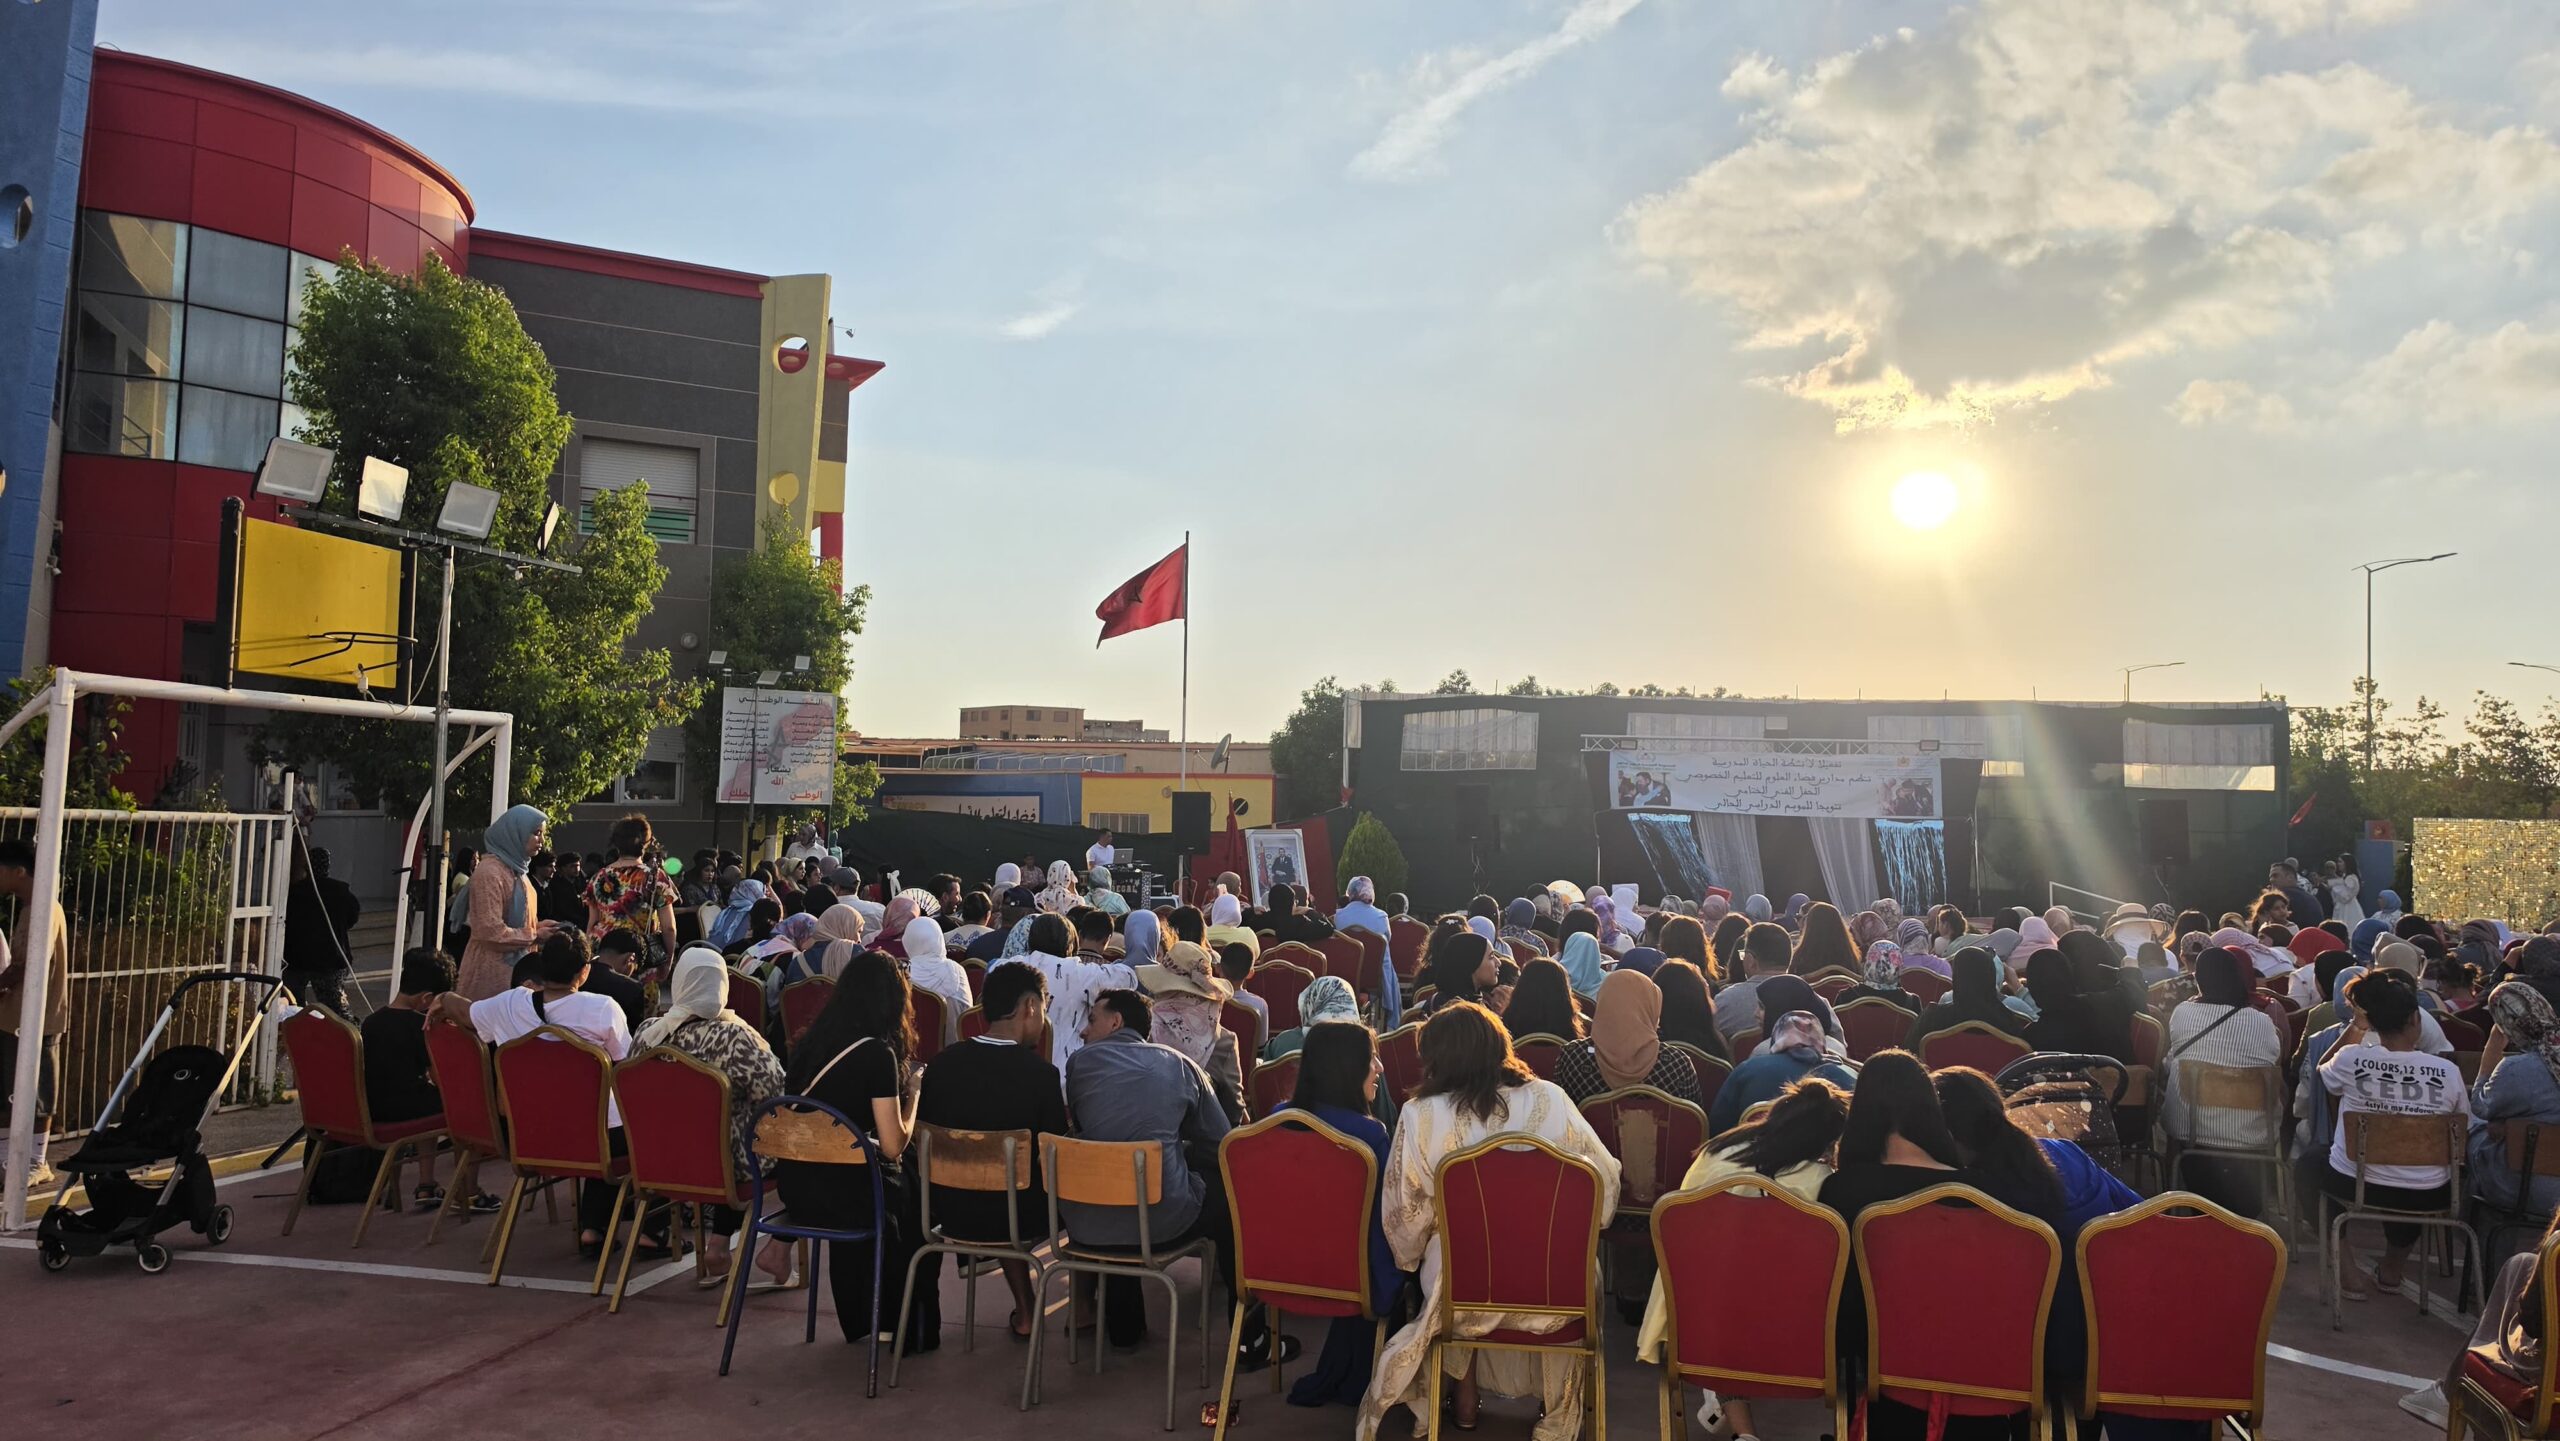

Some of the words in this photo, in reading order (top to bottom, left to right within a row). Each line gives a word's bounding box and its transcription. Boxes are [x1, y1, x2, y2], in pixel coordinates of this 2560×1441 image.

[1711, 757, 1749, 769] المدرسية
[1752, 757, 1779, 768] الحياة
[771, 776, 784, 786] الله
[1675, 770, 1730, 784] الخصوصي
[1733, 770, 1762, 783] للتعليم
[1765, 771, 1791, 786] العلوم
[790, 789, 823, 801] الوطن
[1722, 785, 1768, 798] الختامي
[1791, 786, 1820, 800] الحفل
[1703, 798, 1742, 810] الحالي
[1736, 799, 1781, 812] الدراسي
[1785, 800, 1813, 814] للموسم
[1816, 801, 1842, 814] تتويجا
[2353, 1057, 2360, 1068] 4
[2419, 1066, 2446, 1078] STYLE
